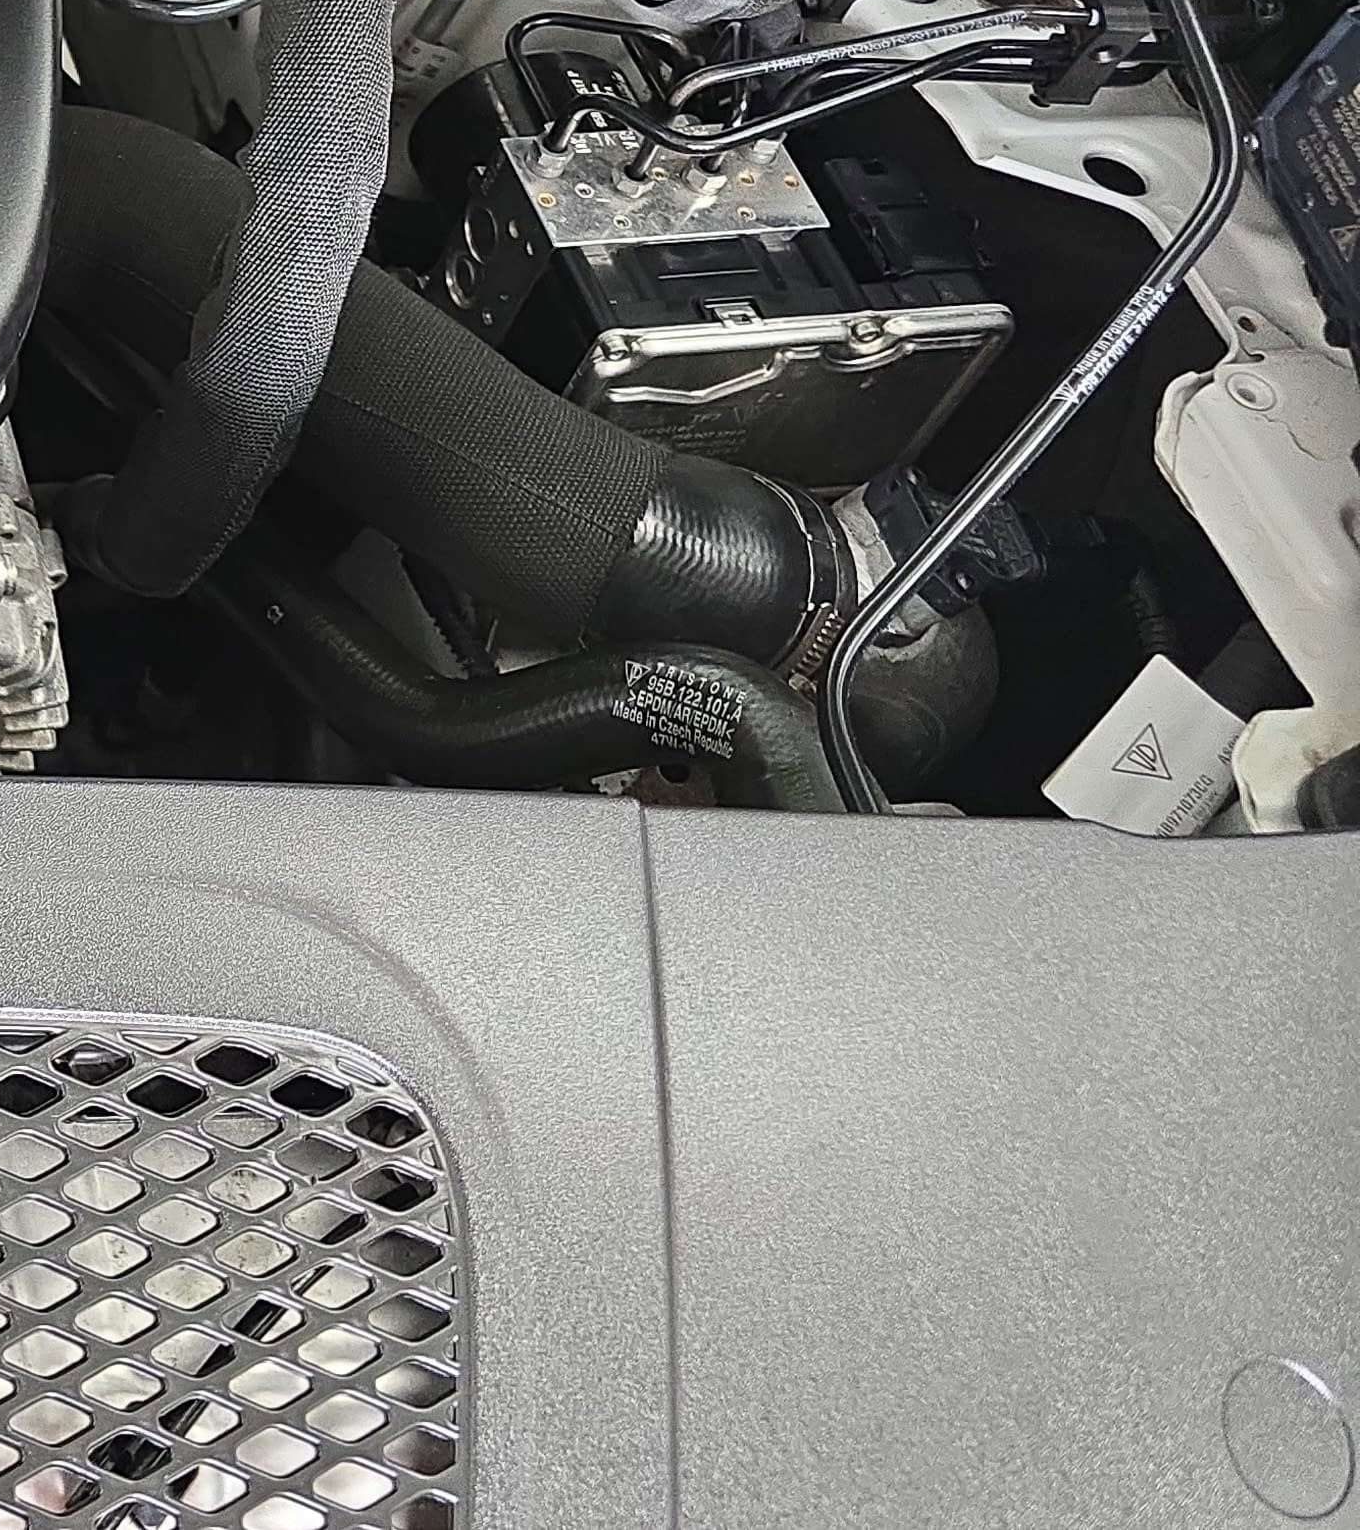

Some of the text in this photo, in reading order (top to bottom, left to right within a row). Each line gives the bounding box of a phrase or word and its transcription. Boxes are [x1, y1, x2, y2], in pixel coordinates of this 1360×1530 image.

[1072, 347, 1103, 376] Made
[1101, 306, 1138, 342] Poland
[646, 674, 743, 724] 95B.122.101.A
[654, 661, 748, 704] TRISTONE
[611, 699, 643, 725] Made
[658, 715, 692, 742] Czech
[693, 728, 734, 759] Republic
